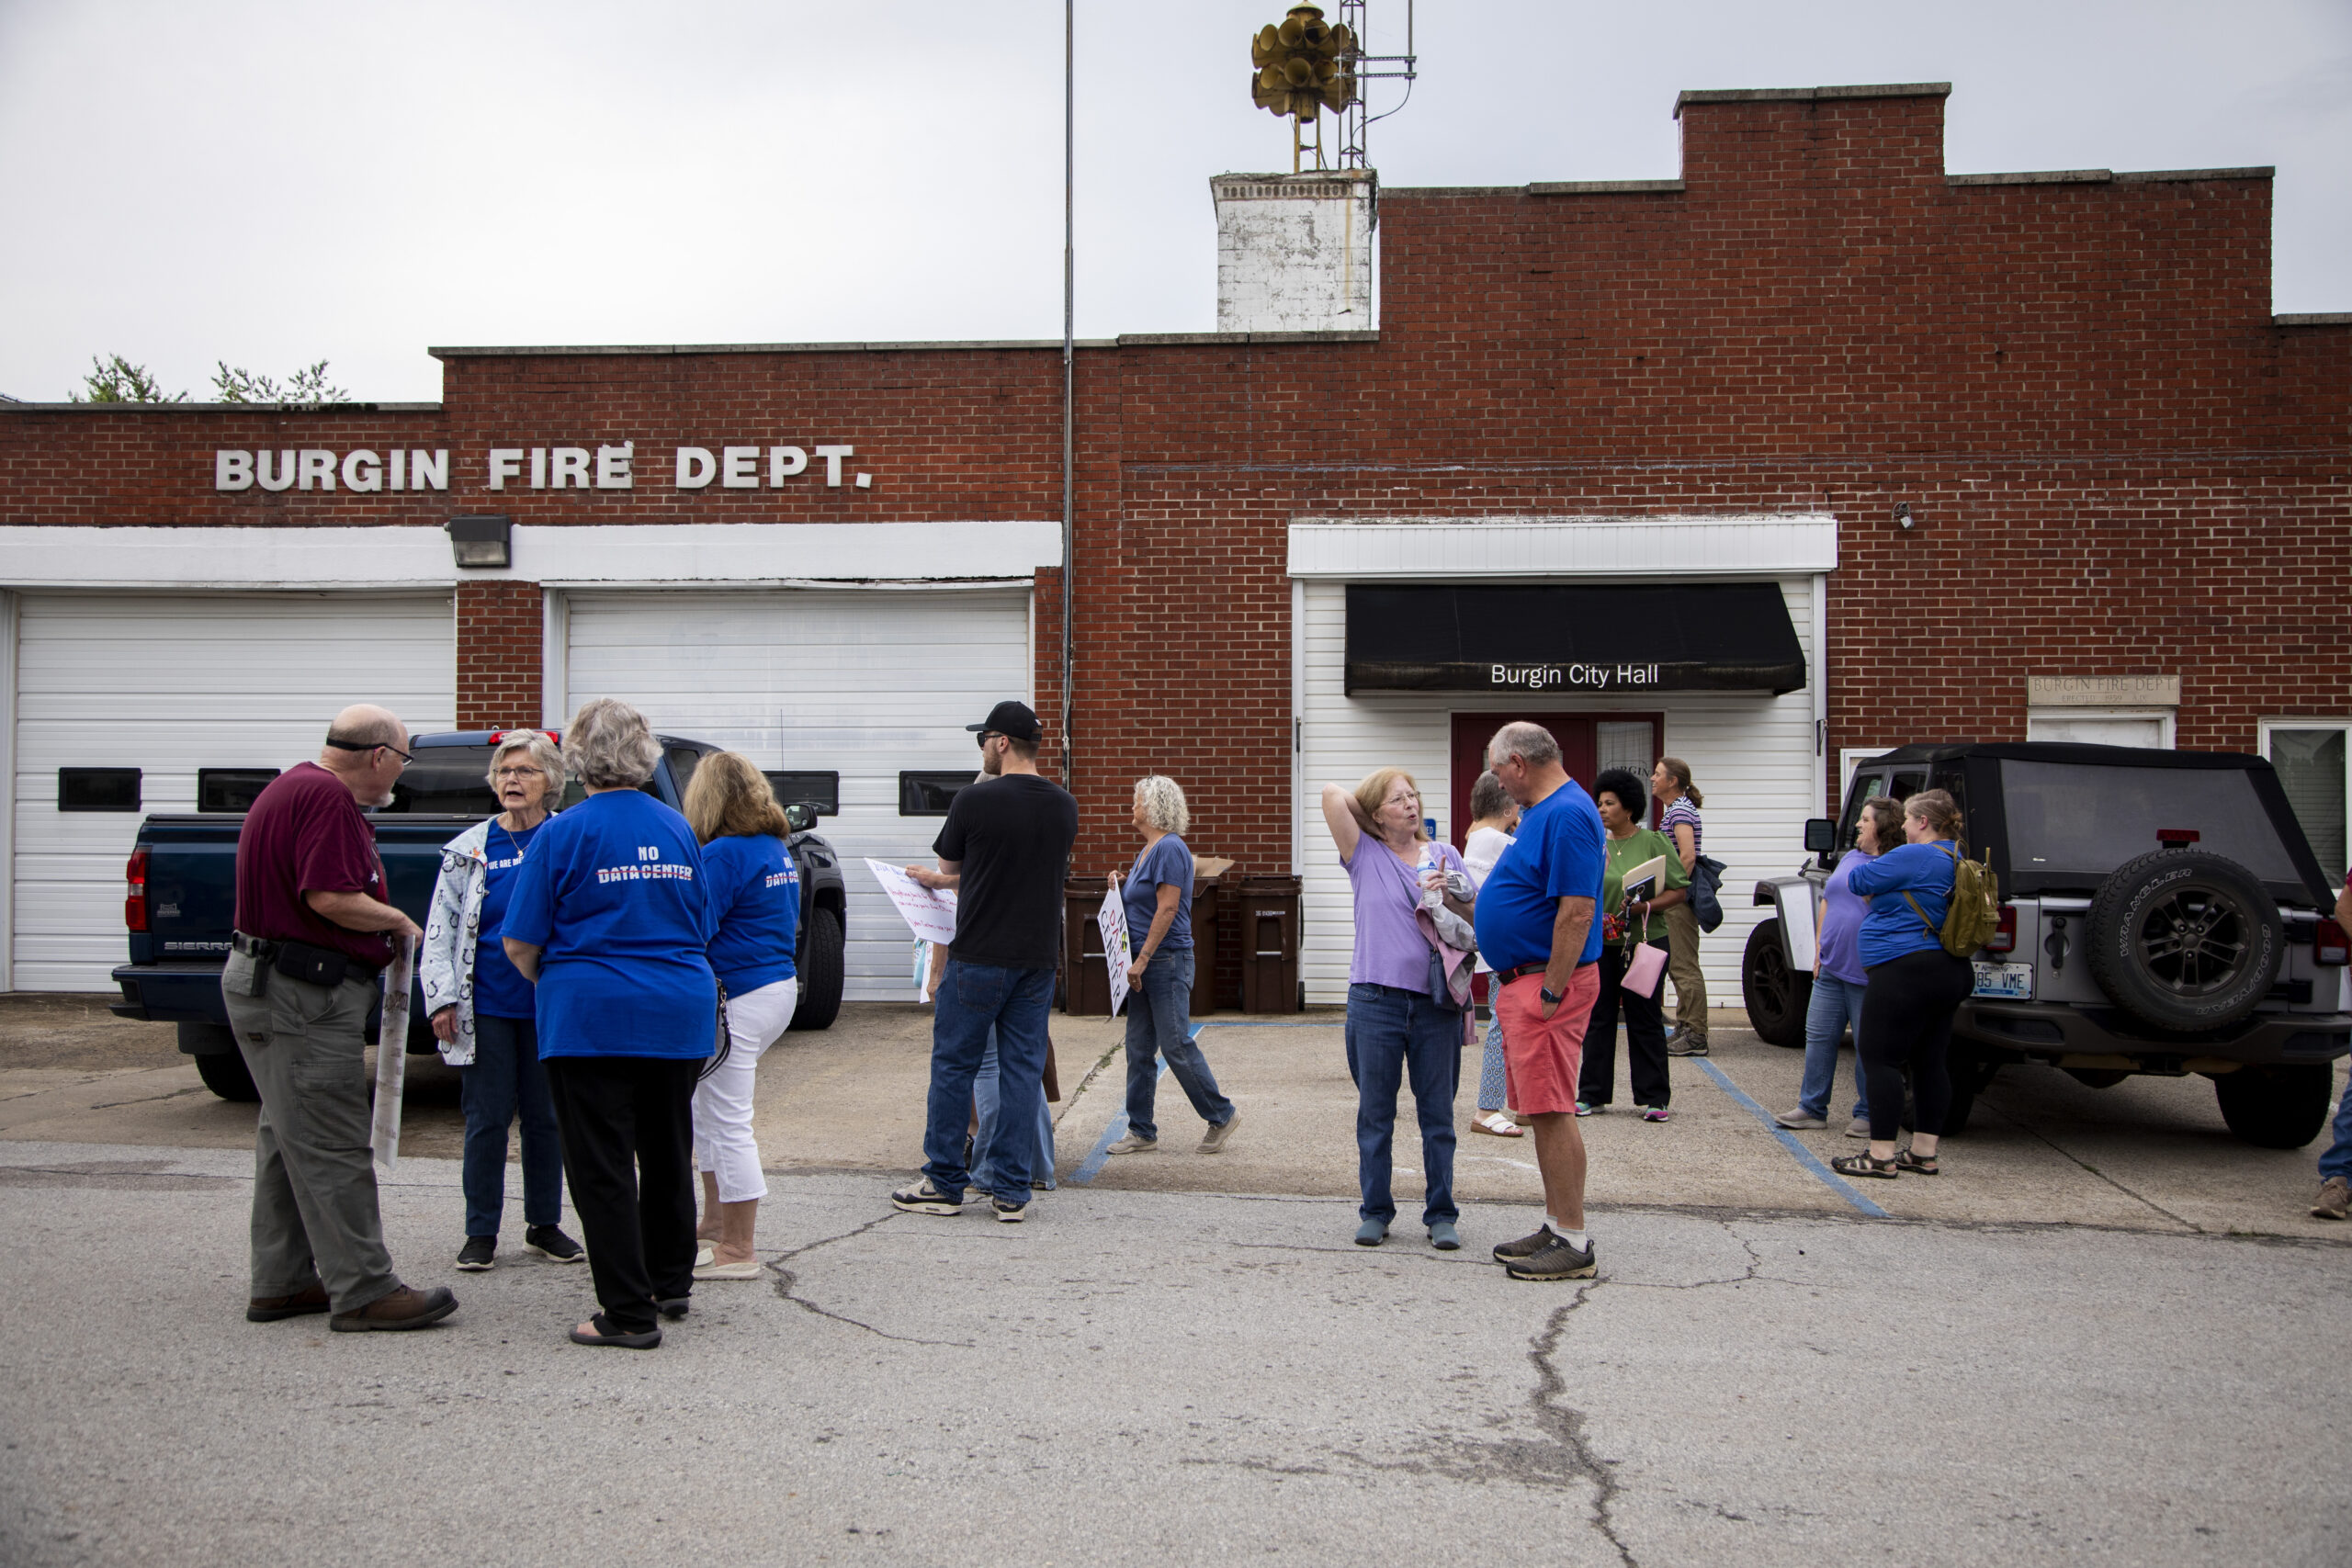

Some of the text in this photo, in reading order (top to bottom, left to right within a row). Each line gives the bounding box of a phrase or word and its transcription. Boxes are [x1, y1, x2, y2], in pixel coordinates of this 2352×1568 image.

[215, 445, 872, 491] BURGIN FIRE DEPT.
[1491, 664, 1658, 688] Burgin City Hall
[2033, 677, 2090, 692] BURGIN
[2098, 677, 2129, 692] FIRE
[638, 846, 660, 861] NO
[783, 856, 793, 869] NO
[488, 860, 499, 870] WE
[499, 859, 512, 868] ARE
[597, 864, 694, 884] DATA CENTER
[765, 872, 788, 888] DATA
[2120, 869, 2192, 957] WRANGLER
[1110, 909, 1125, 978] DATA
[1101, 910, 1121, 1009] CENTER
[2195, 924, 2272, 1015] GOODYEAR
[1974, 971, 2025, 989] 85 VME
